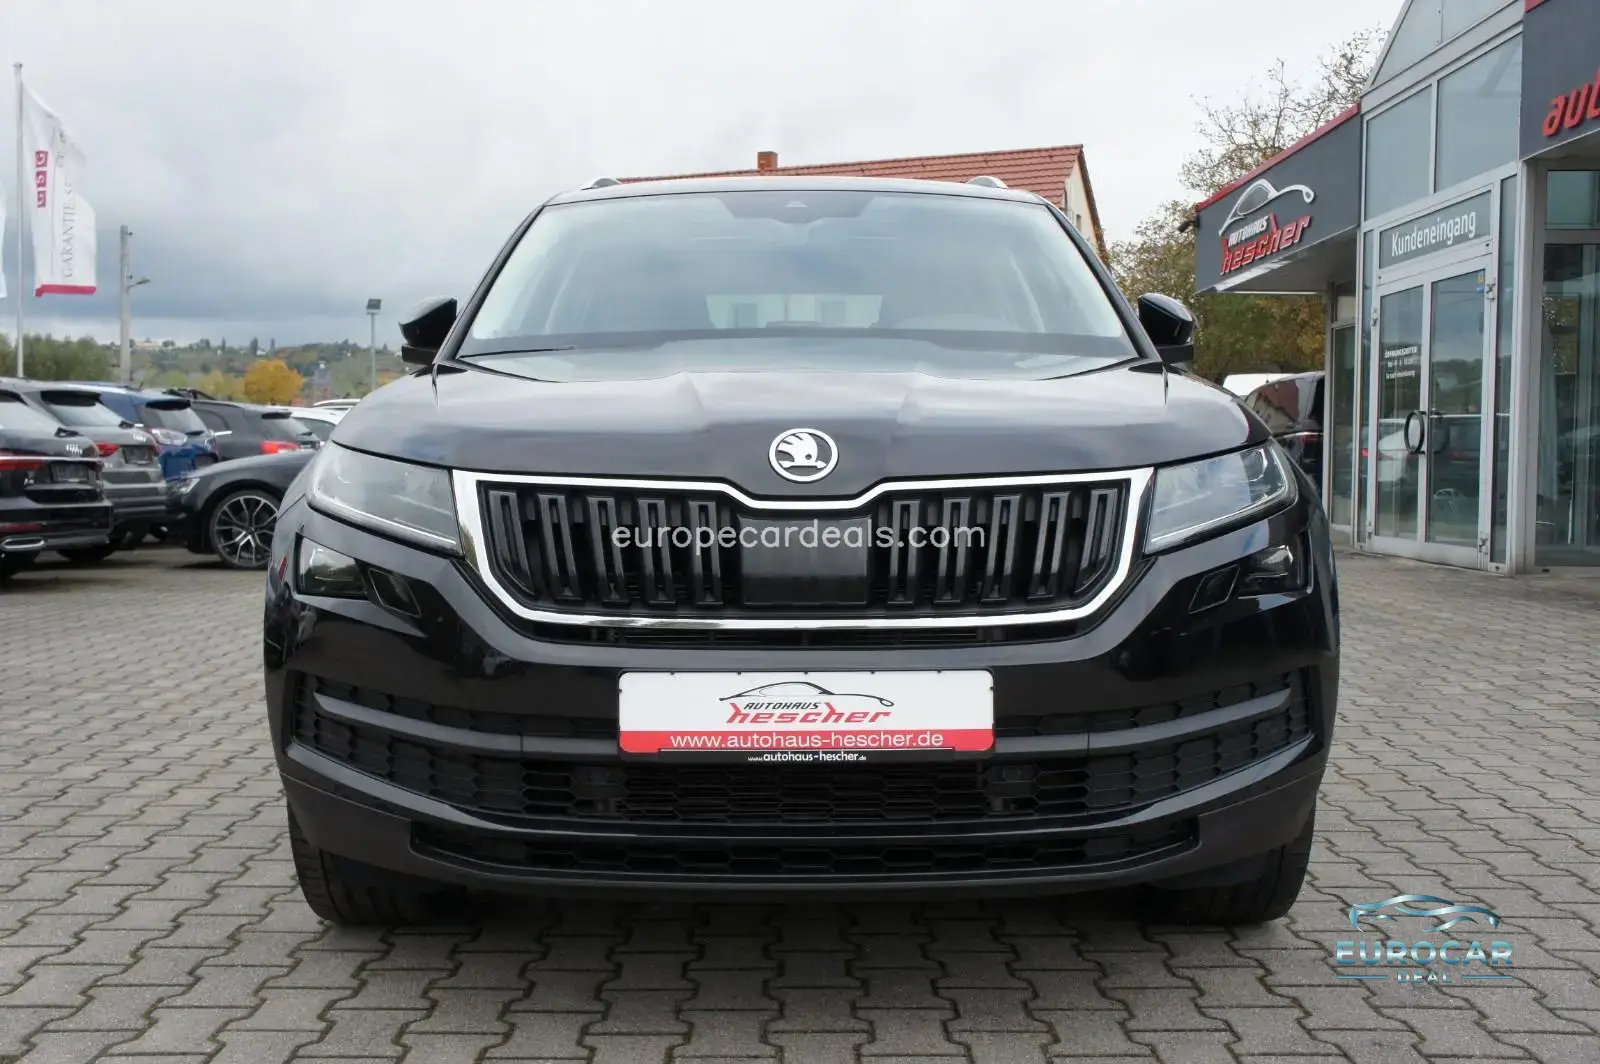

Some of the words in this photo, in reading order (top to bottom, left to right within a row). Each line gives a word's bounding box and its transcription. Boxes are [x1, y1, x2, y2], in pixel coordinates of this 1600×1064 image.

[1228, 215, 1269, 247] AUTOHAUS
[1391, 211, 1476, 256] Kundeneingang
[1220, 212, 1312, 275] hescher
[725, 702, 893, 724] hescher
[743, 702, 823, 711] AUTOHAUS
[670, 730, 944, 749] www.autohaus-hescher.de
[747, 751, 868, 762] www.autohaus-hescher.de
